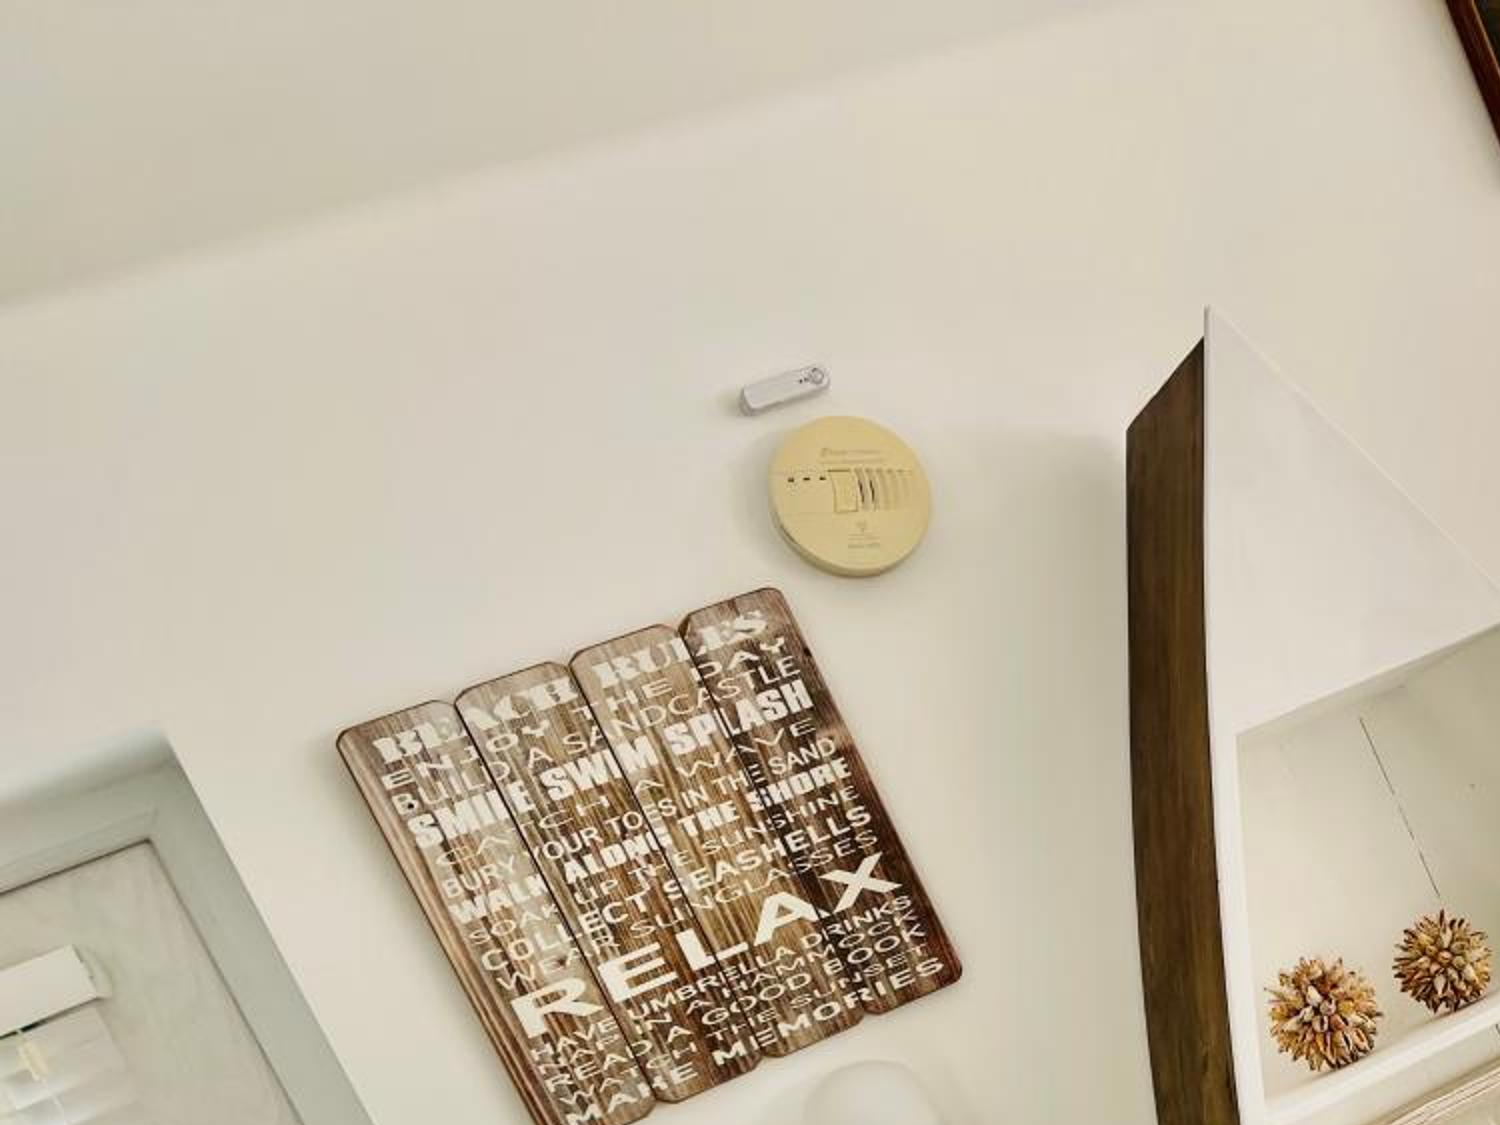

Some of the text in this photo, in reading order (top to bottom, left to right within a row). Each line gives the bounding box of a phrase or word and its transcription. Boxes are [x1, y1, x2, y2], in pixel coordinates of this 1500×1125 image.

[372, 609, 767, 764] BEACH RULES
[382, 636, 785, 790] ENJOY THE DAY
[391, 656, 801, 816] BUILD A SANDCASTLE
[407, 679, 815, 850] SMILE SWIM SPLASH
[438, 716, 818, 867] CATCH A WAVE
[443, 737, 836, 899] BURY YOUR TOES IN THE SAND
[450, 757, 852, 923] WALK ALONG THE SHORE
[468, 785, 860, 946] SOAK UP THE SUNSHINE
[481, 805, 872, 972] COLLECT SEASHELLS
[496, 828, 879, 991] WEAR SUNGLASSES
[511, 851, 903, 1038] RELAX
[531, 895, 912, 1062] HAVE UMBRELLA DRINKS
[545, 923, 927, 1092] READ A GOOD BOOK
[560, 943, 929, 1106] WATCH THE SUNSET
[634, 1012, 674, 1034] IN
[686, 999, 712, 1016] A
[722, 911, 919, 999] HAMMOCK
[712, 957, 945, 1066] MEMORIES
